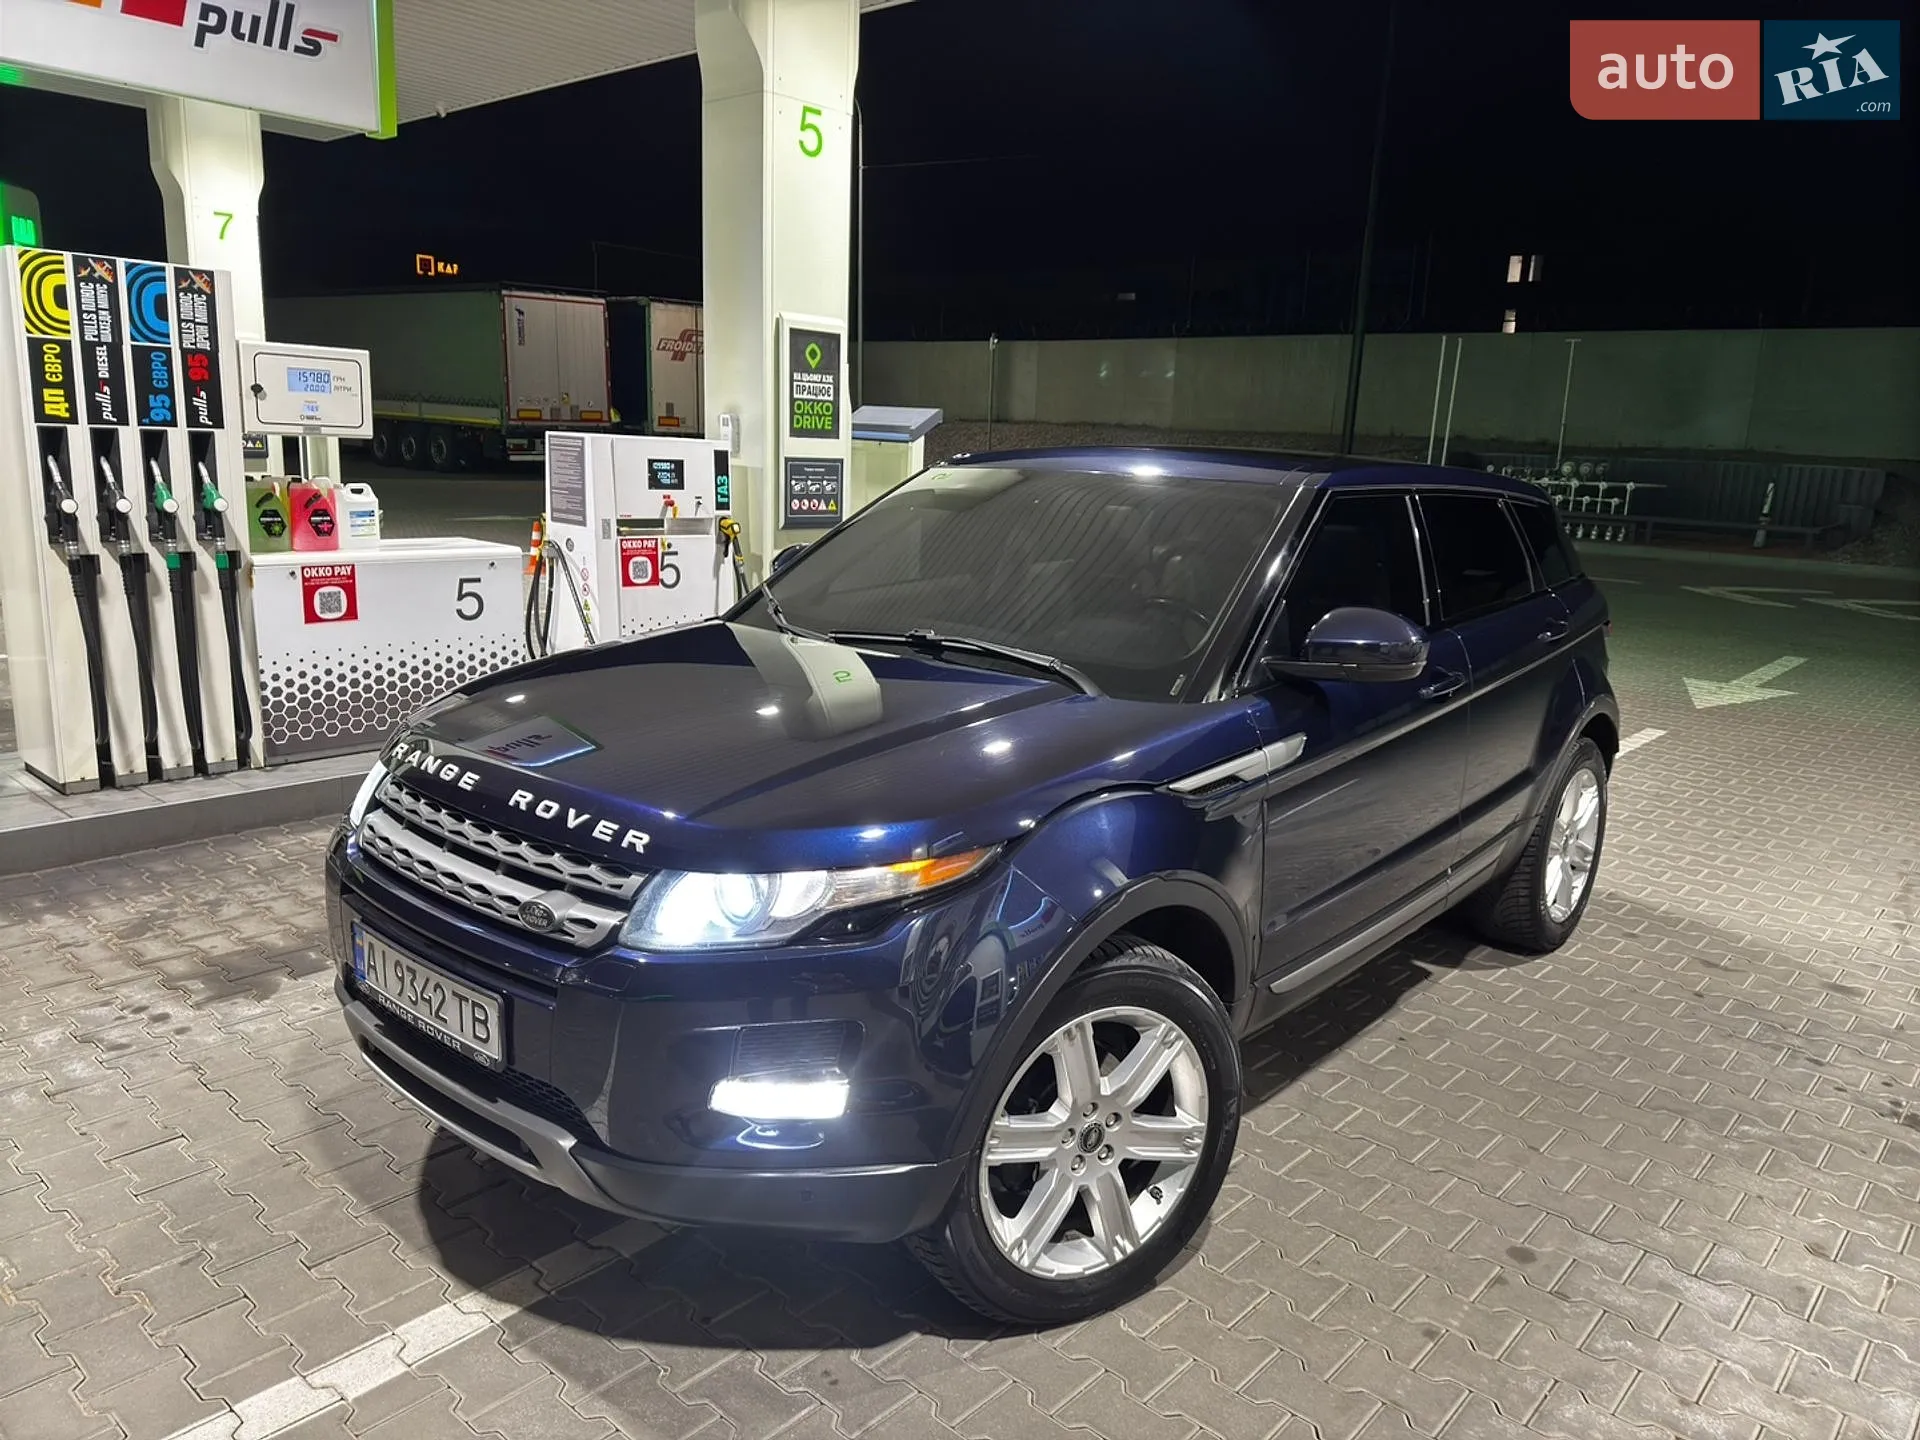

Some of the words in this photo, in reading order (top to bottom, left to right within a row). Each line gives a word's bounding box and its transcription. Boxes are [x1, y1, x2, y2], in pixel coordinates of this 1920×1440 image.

[194, 0, 338, 57] pulls
[798, 105, 823, 158] 5
[212, 210, 234, 240] 7
[82, 313, 98, 342] PULLS
[181, 322, 195, 349] PULLS
[96, 345, 110, 378] DIESEL
[187, 353, 209, 381] 95
[42, 387, 70, 418] ДП
[94, 380, 117, 422] pulls
[191, 386, 213, 425] pulls
[795, 384, 832, 398] ПРАЦЮЄ
[149, 394, 172, 422] 95
[793, 415, 833, 430] DRIVE
[794, 400, 833, 415] OKKO
[717, 475, 729, 503] ГАЗ
[621, 539, 642, 549] OKKO
[643, 539, 657, 549] PAY
[303, 566, 332, 578] OKKO
[333, 565, 352, 577] PAY
[660, 550, 681, 589] 5
[456, 577, 484, 621] 5
[391, 742, 480, 791] RANGE
[508, 789, 651, 854] ROVER
[367, 942, 387, 989] AI
[394, 959, 448, 1024] 9342
[451, 990, 491, 1045] TB
[378, 994, 415, 1025] RANGE
[418, 1019, 462, 1051] ROVER
